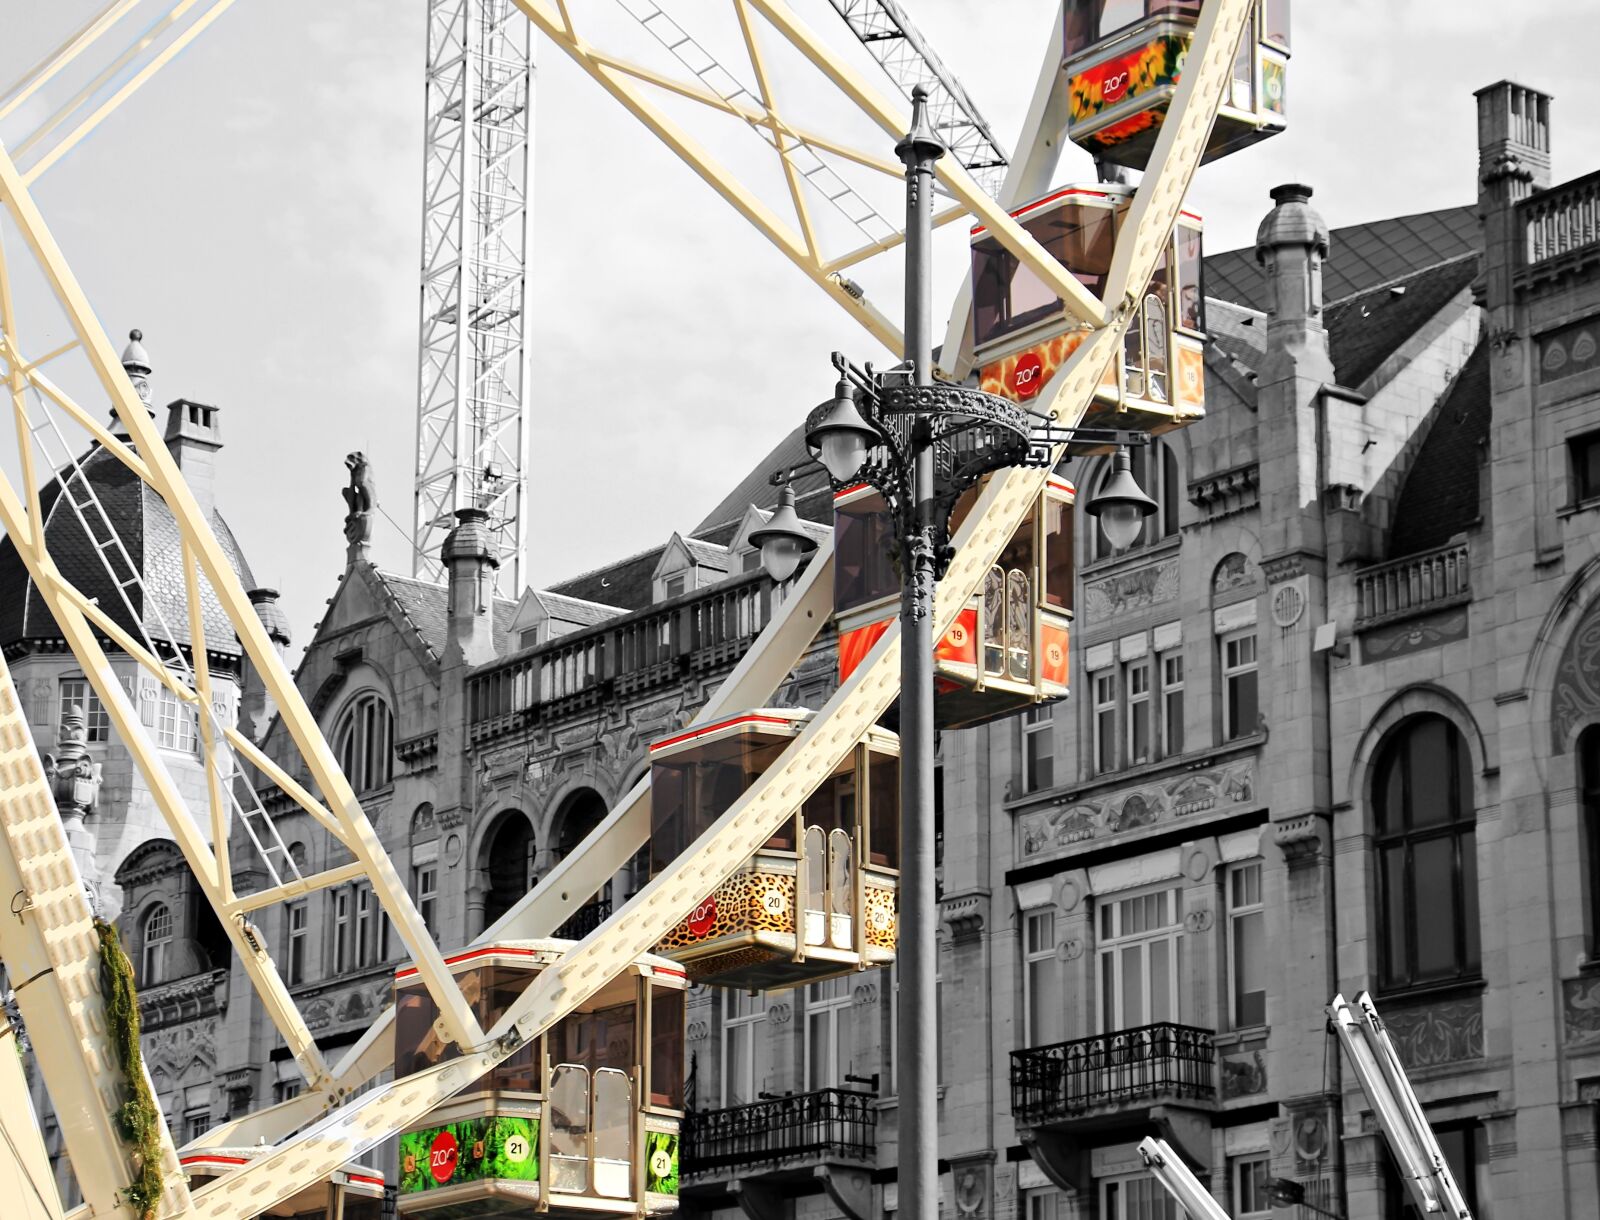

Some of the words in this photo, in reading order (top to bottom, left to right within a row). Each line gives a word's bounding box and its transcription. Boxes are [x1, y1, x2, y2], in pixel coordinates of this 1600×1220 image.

[952, 630, 962, 640] 19
[1050, 649, 1059, 660] 19
[768, 897, 780, 908] 20
[874, 912, 885, 923] 20
[510, 1142, 522, 1154] 21
[656, 1157, 666, 1169] 21
